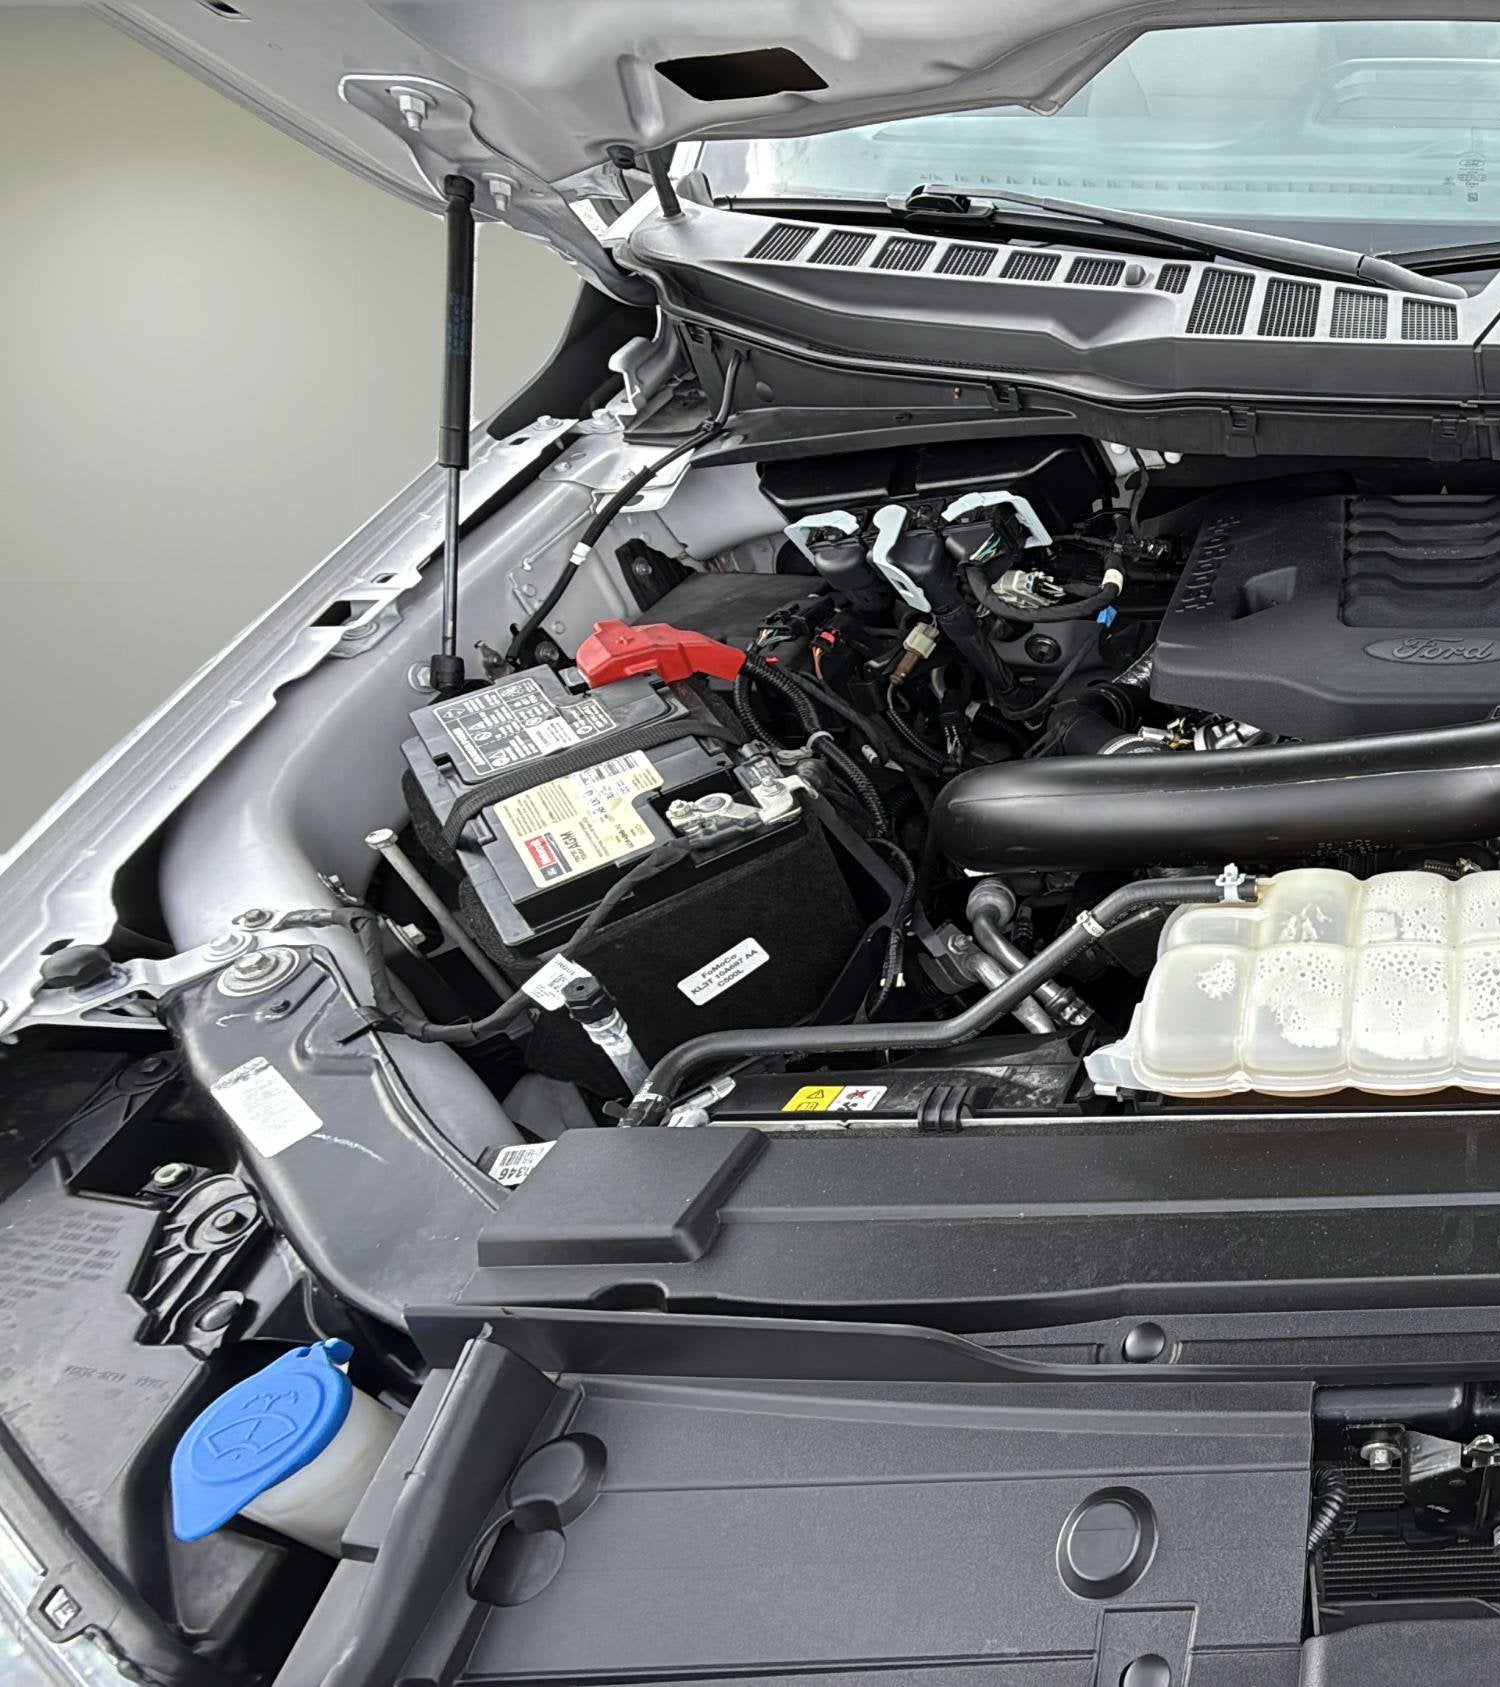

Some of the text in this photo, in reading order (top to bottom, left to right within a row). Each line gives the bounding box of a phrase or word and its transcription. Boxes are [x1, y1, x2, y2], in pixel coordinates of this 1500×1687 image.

[1392, 637, 1494, 660] Ford
[560, 830, 581, 850] AGM
[691, 978, 713, 995] KL3T
[745, 949, 758, 960] AA
[701, 954, 738, 979] FoMoCo
